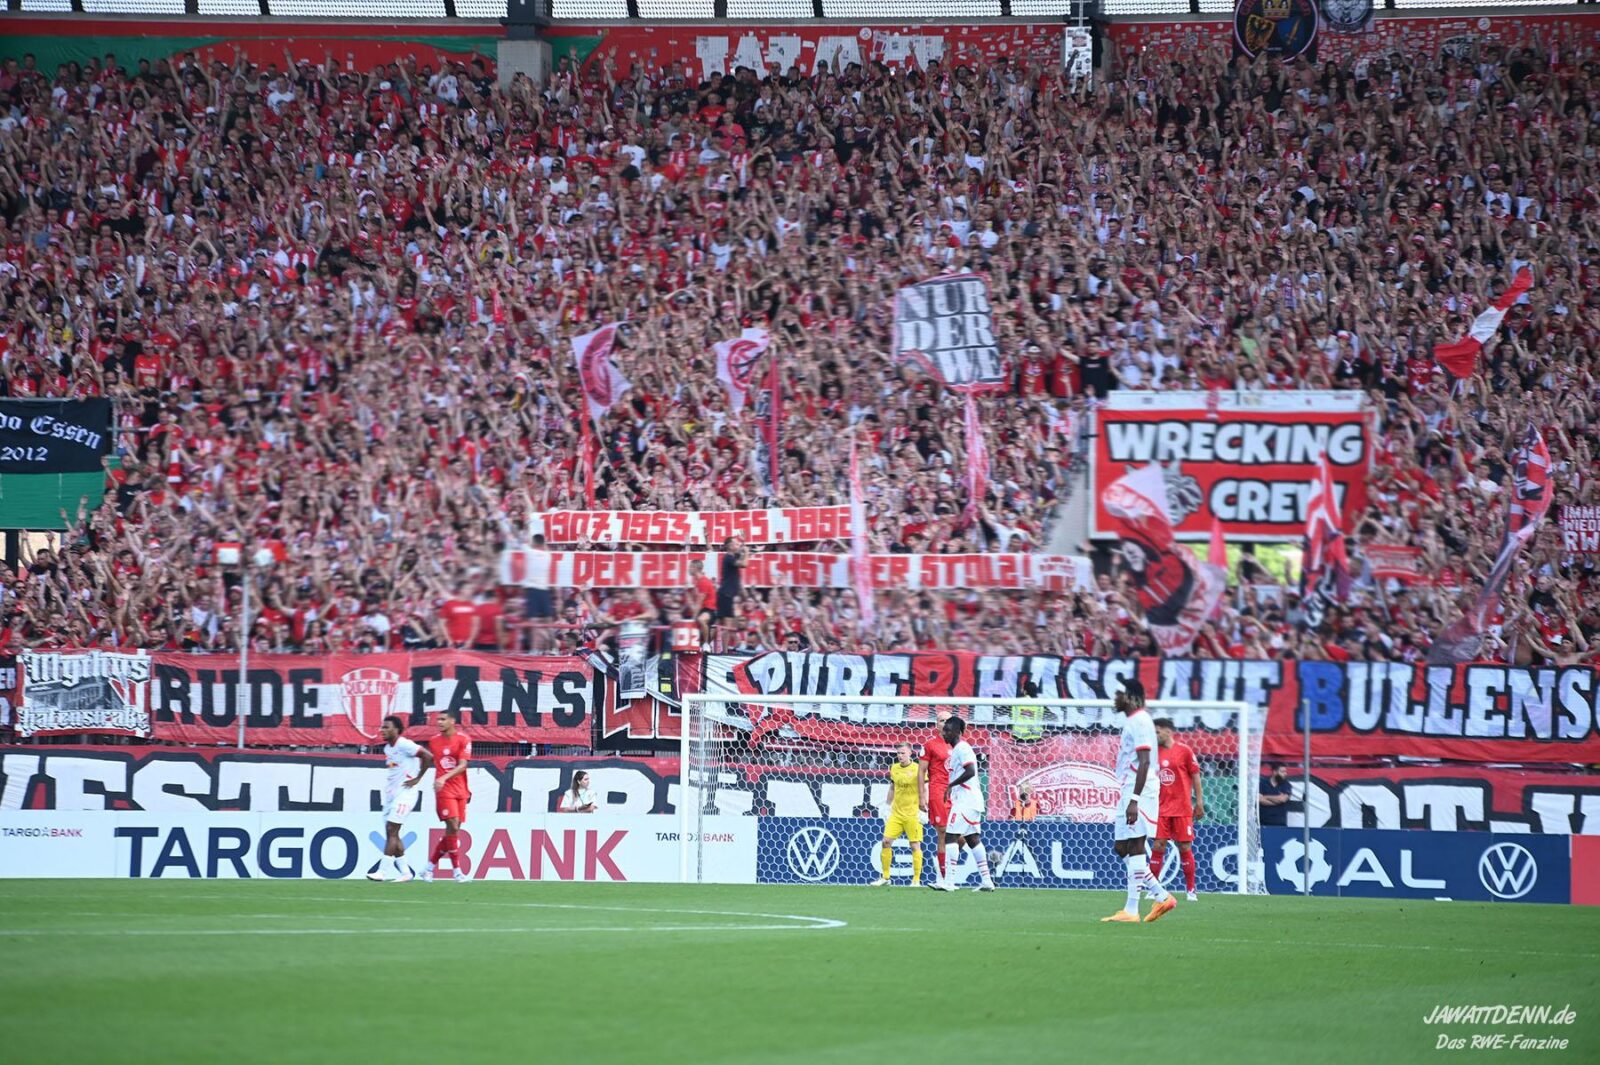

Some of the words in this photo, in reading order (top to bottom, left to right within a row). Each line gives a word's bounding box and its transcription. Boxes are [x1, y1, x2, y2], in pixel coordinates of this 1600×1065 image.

[900, 281, 990, 319] NUR
[898, 315, 996, 351] DER
[924, 347, 1004, 383] WE
[30, 415, 101, 449] Essen
[1106, 421, 1364, 464] WRECKING
[0, 446, 48, 461] 2012
[1564, 519, 1600, 531] WIED
[572, 552, 635, 587] DER
[718, 552, 838, 587] ÄCHST
[848, 555, 909, 589] ER
[154, 663, 324, 728] RUDE
[411, 665, 586, 728] FANS
[748, 651, 977, 724] PURER
[978, 652, 1137, 730] HASS
[1158, 659, 1281, 730] AUF
[1296, 660, 1600, 741] BULLENS
[114, 827, 359, 879] TARGO
[428, 827, 630, 881] BANK
[871, 838, 1094, 882] GAL
